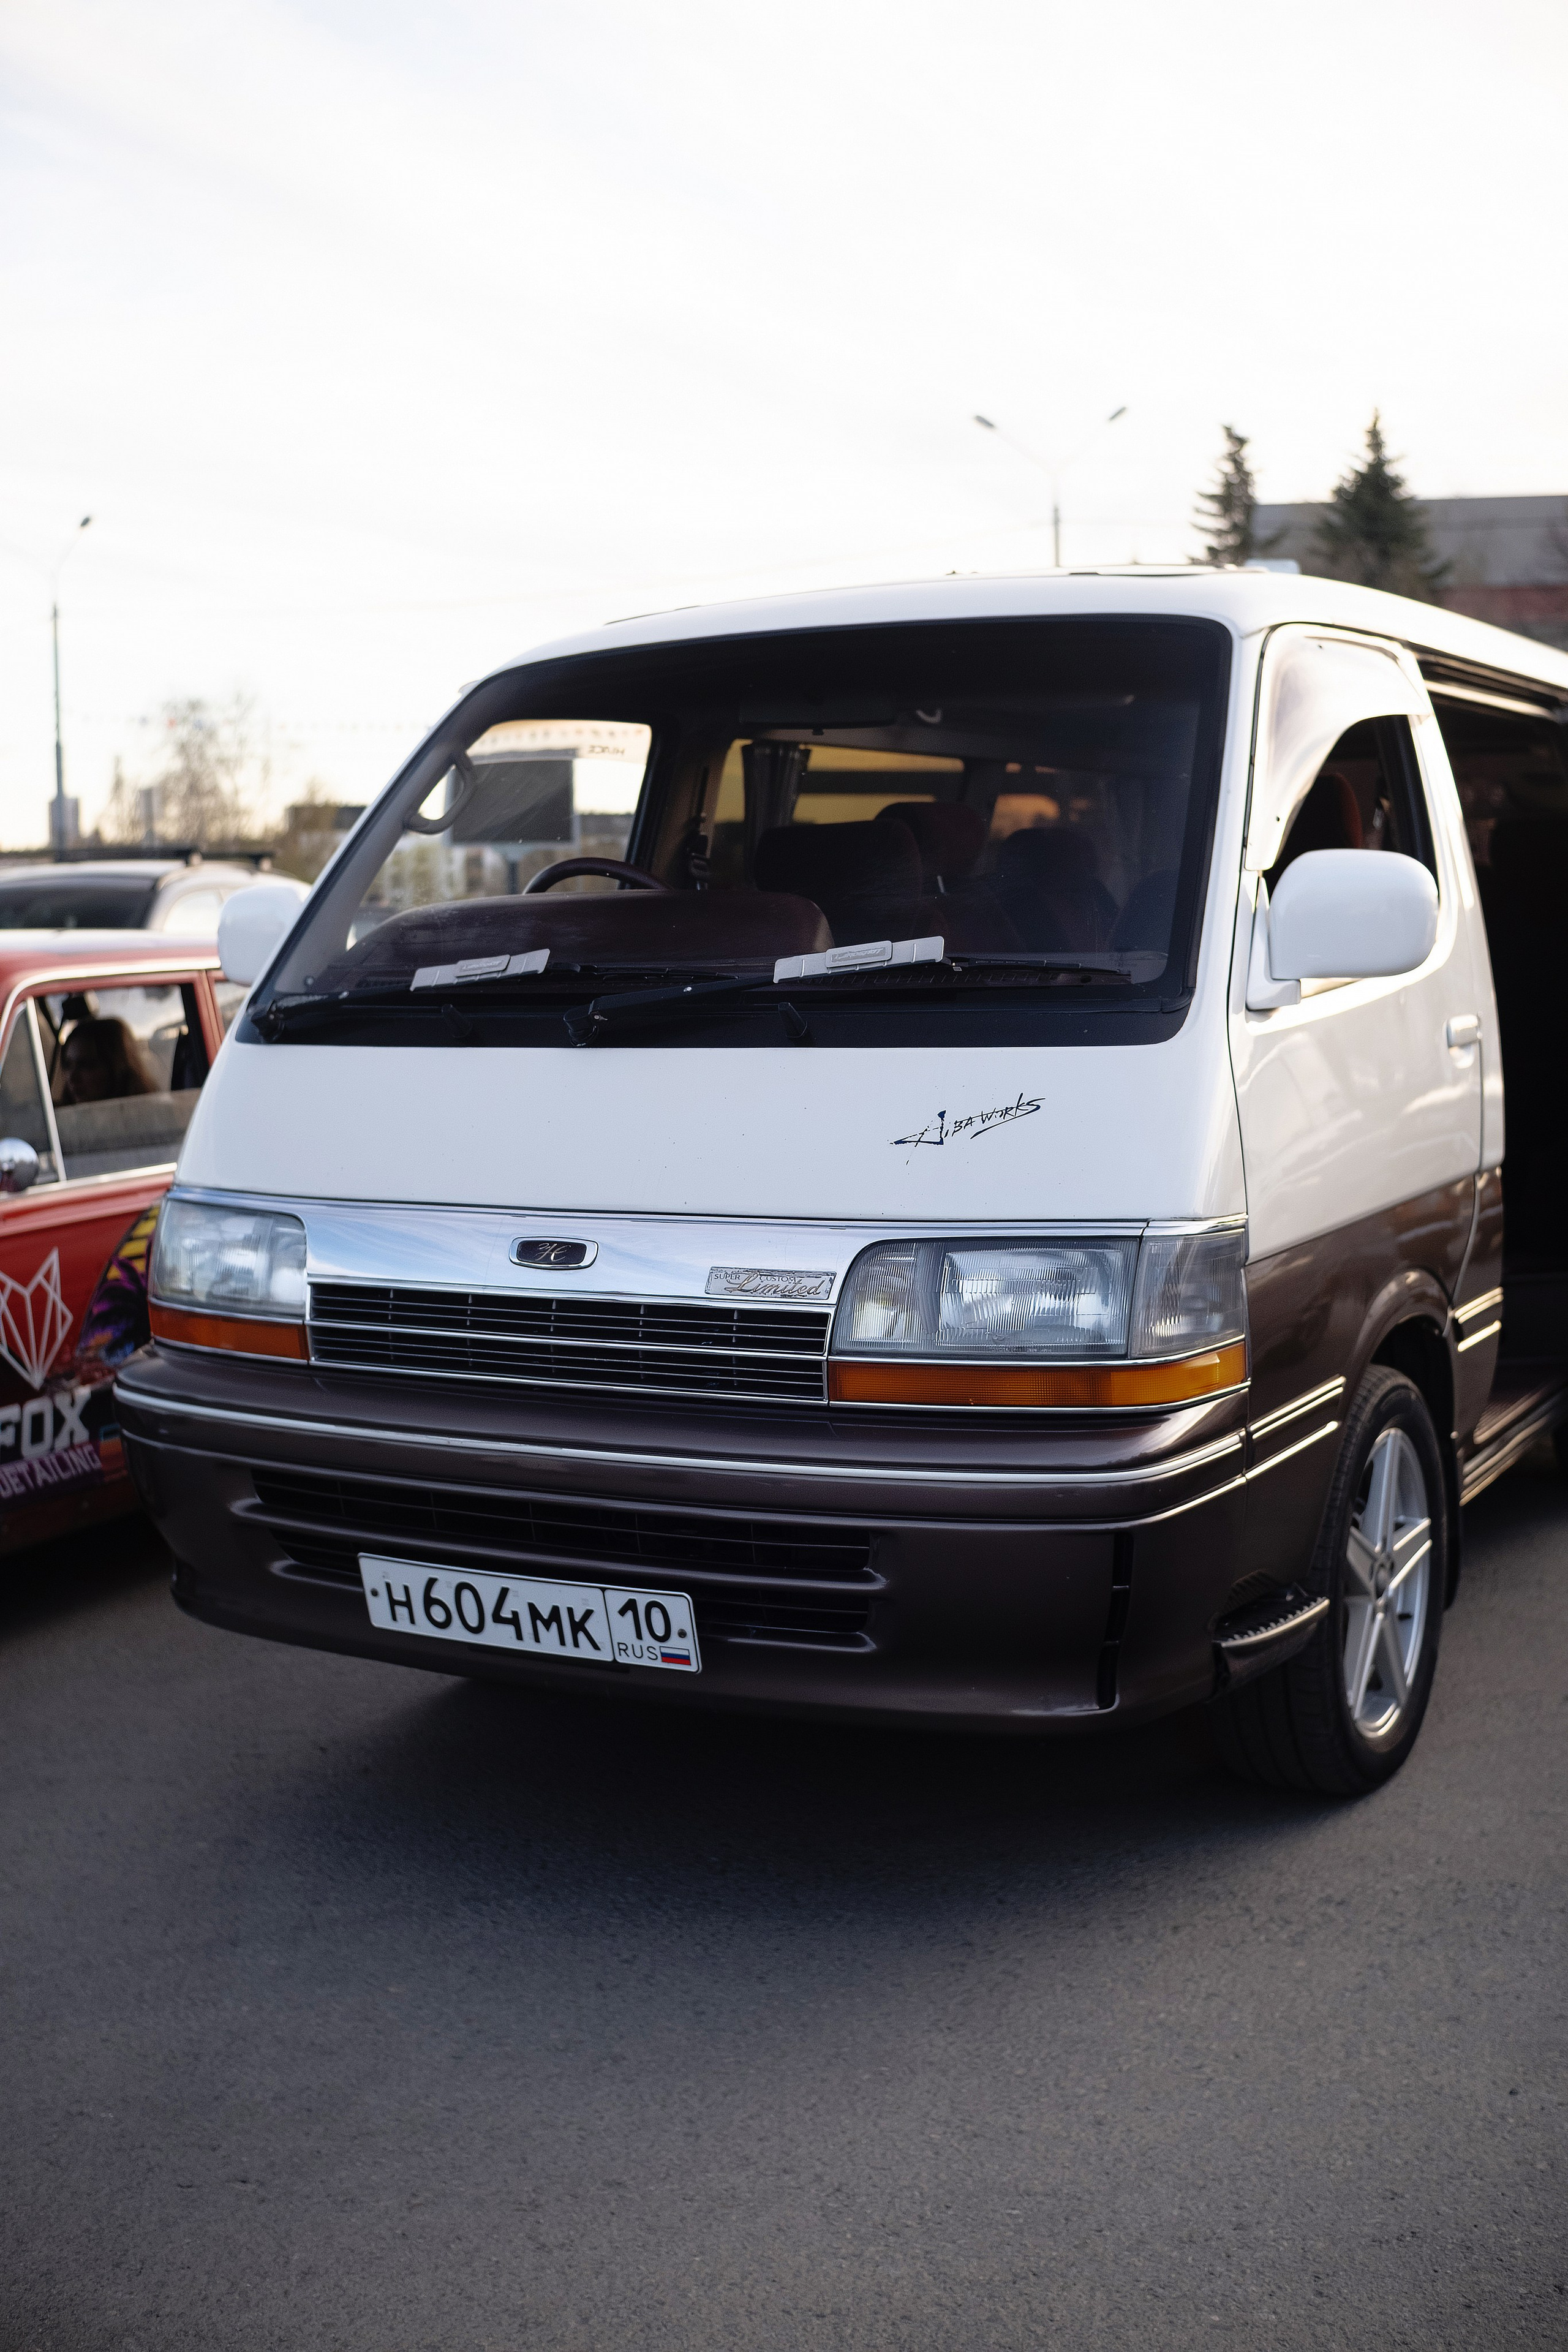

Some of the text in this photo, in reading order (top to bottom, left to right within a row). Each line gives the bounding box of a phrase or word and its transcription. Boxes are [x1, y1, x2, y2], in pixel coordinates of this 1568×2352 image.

[724, 1272, 826, 1296] Limited
[617, 1597, 673, 1643] 10
[617, 1642, 659, 1662] RUS
